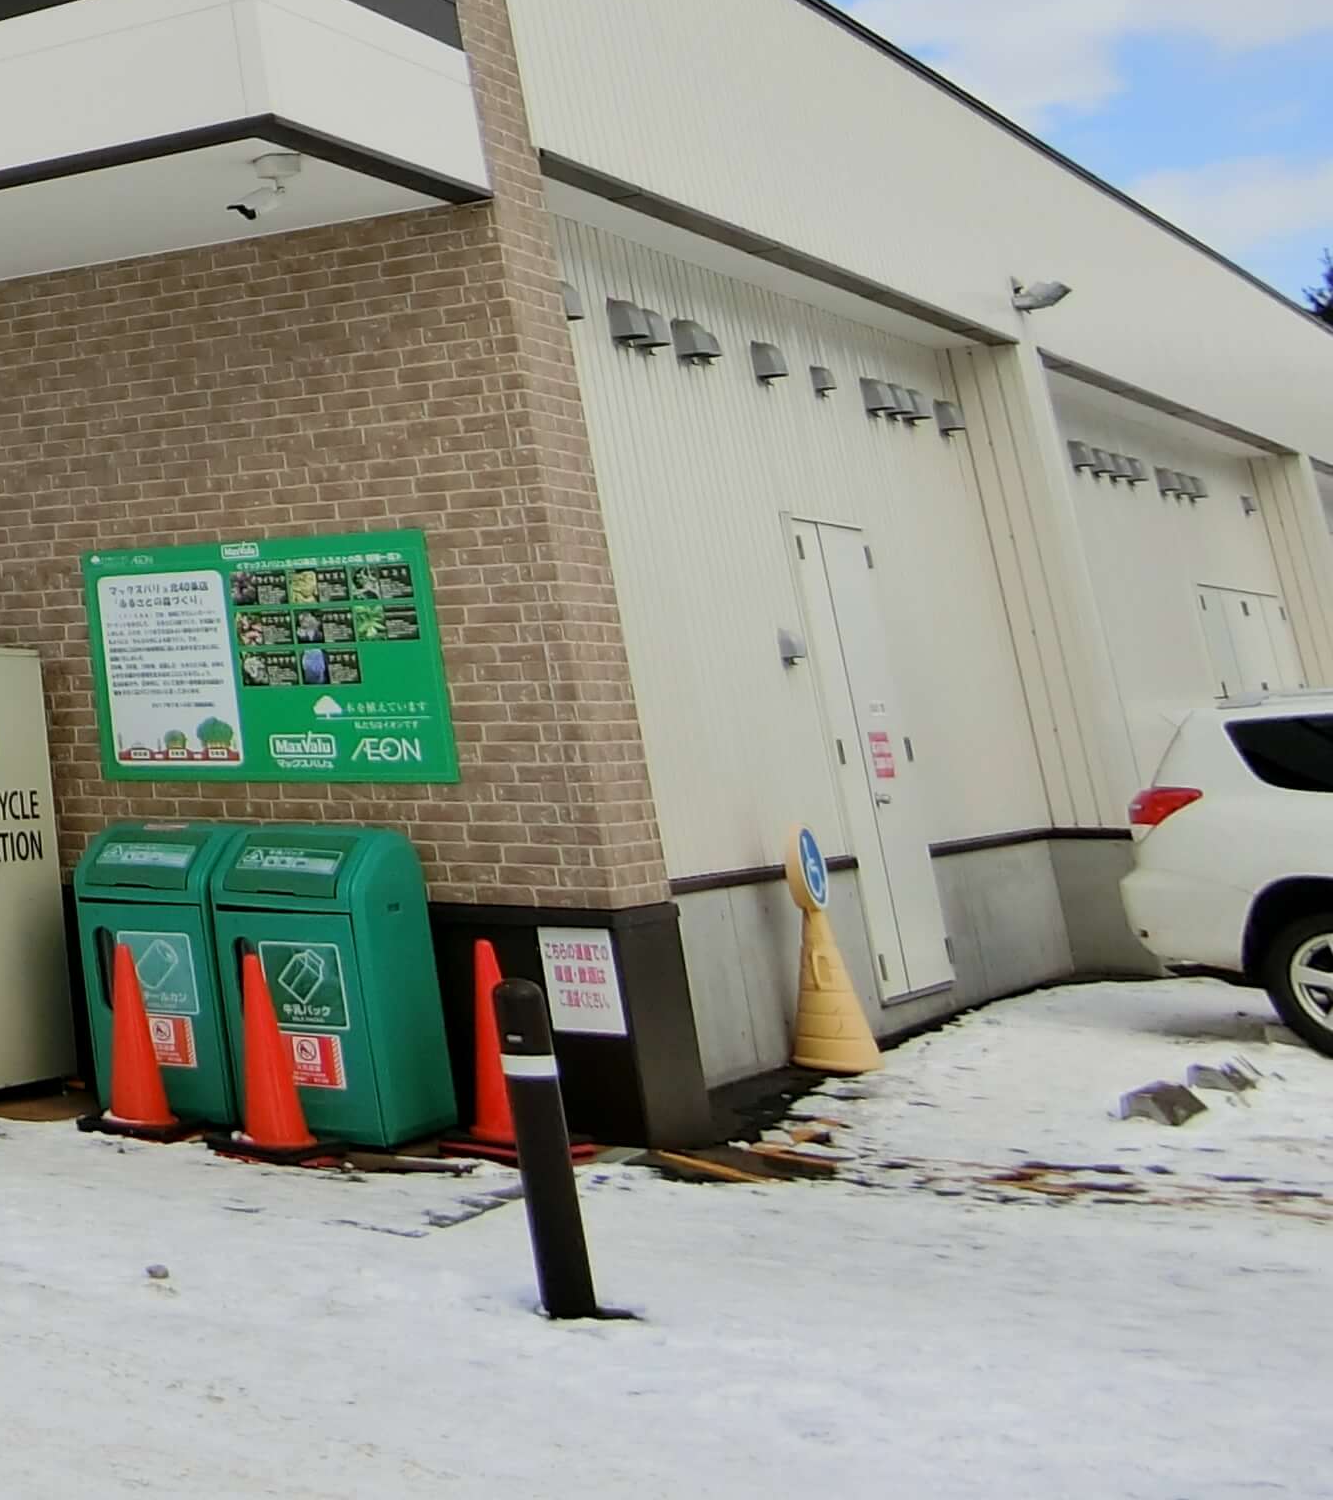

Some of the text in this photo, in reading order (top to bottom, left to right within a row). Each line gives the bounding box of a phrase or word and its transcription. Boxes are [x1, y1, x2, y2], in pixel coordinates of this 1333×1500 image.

[275, 730, 332, 753] MaxValu
[282, 1003, 332, 1017] 牛乳パック
